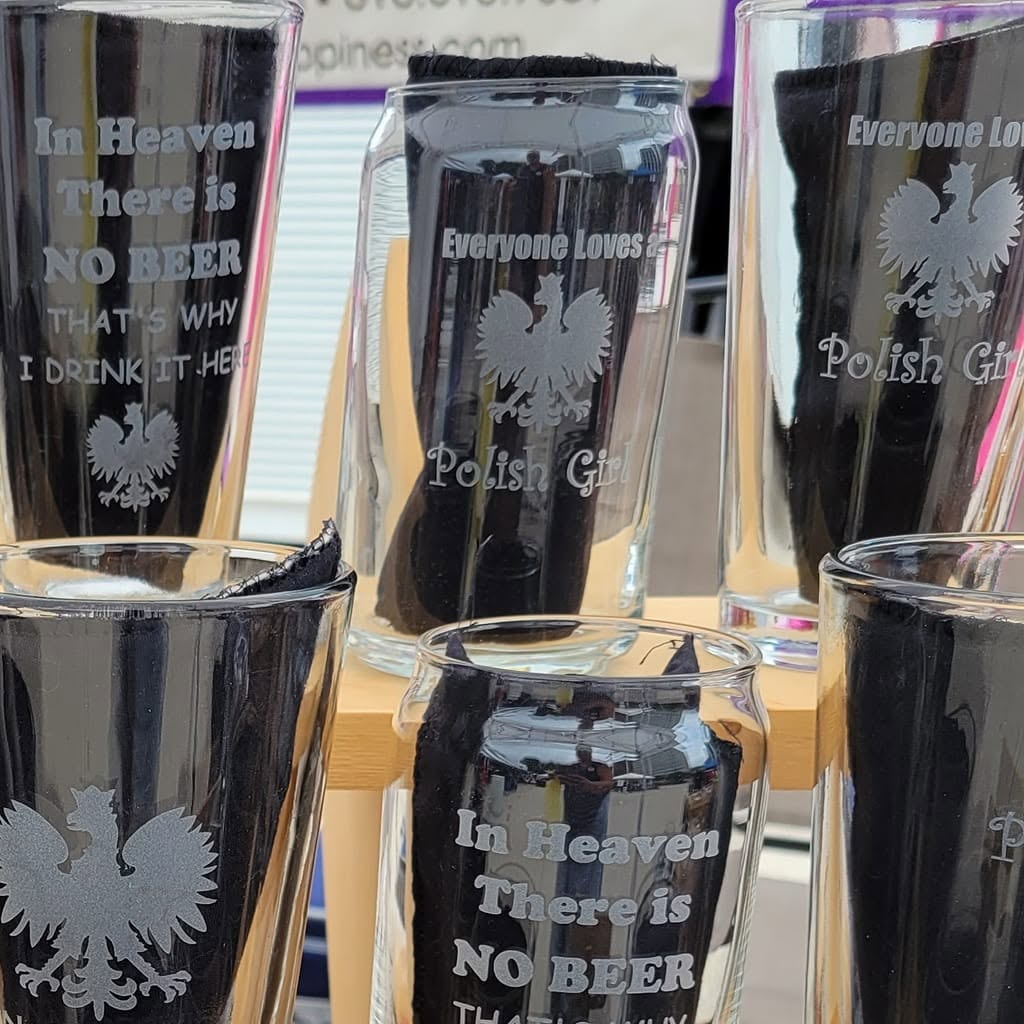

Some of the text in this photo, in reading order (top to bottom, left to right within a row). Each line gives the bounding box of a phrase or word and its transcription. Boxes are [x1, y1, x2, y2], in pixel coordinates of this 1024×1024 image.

[33, 117, 255, 156] In Heaven
[847, 114, 1024, 150] Everyone Lo
[56, 176, 236, 217] There is
[42, 239, 242, 285] NO BEER
[442, 228, 569, 263] Everyone
[575, 229, 643, 260] Loves
[47, 297, 238, 335] THAT'S WHY
[19, 355, 33, 381] I
[45, 357, 144, 385] DRINK
[156, 355, 191, 383] IT
[818, 332, 943, 385] Polish
[427, 441, 632, 497] Polish Girl
[455, 808, 720, 864] In Heaven
[474, 874, 692, 926] There is
[452, 939, 695, 995] NO BEER
